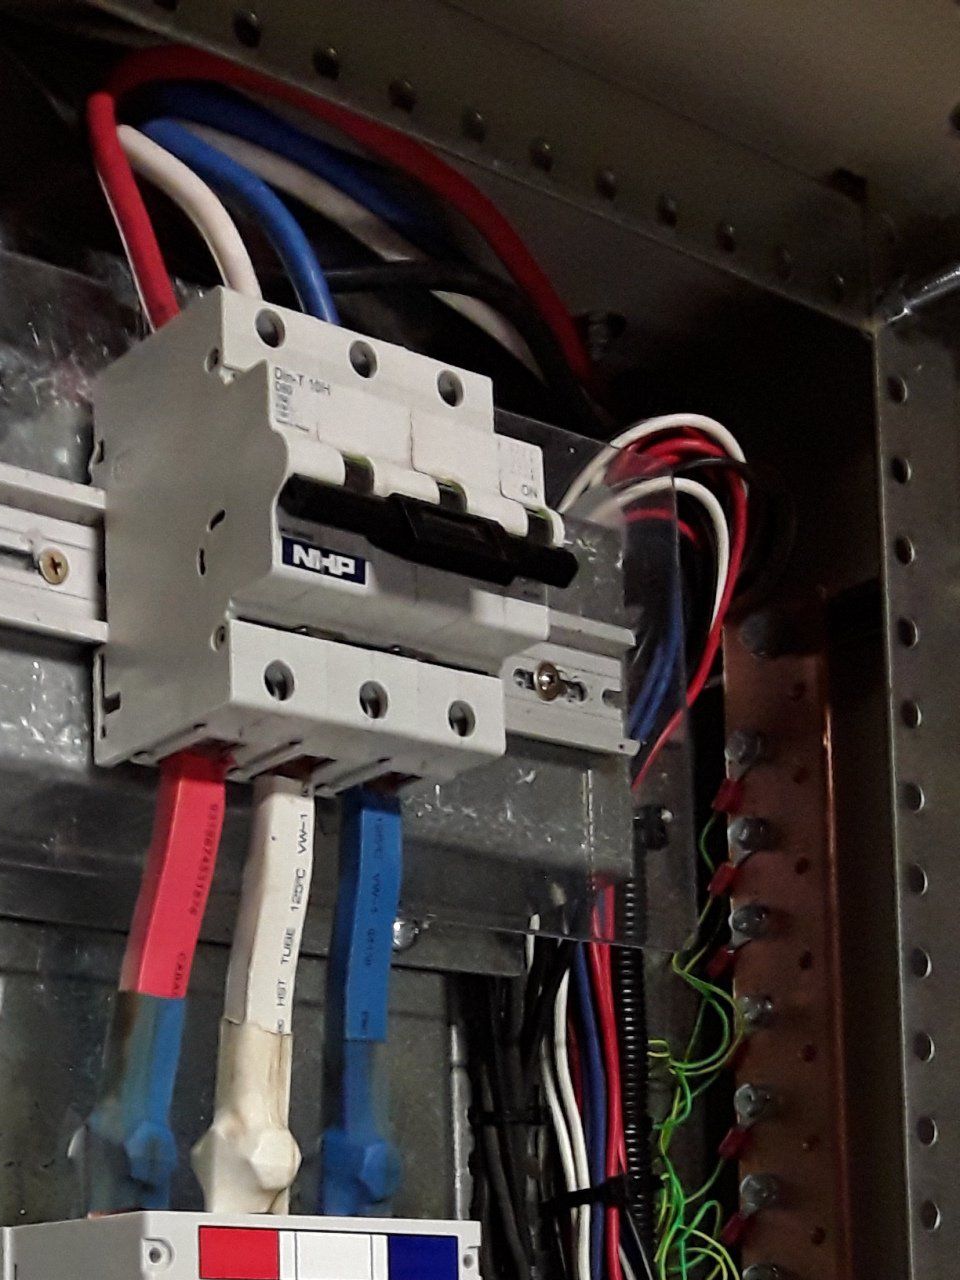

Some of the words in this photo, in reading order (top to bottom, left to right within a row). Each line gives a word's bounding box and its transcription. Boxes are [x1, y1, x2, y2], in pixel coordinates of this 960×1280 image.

[292, 543, 355, 577] NHP
[276, 978, 286, 1007] HST
[281, 927, 296, 965] TUBE
[298, 813, 308, 854] VW-1
